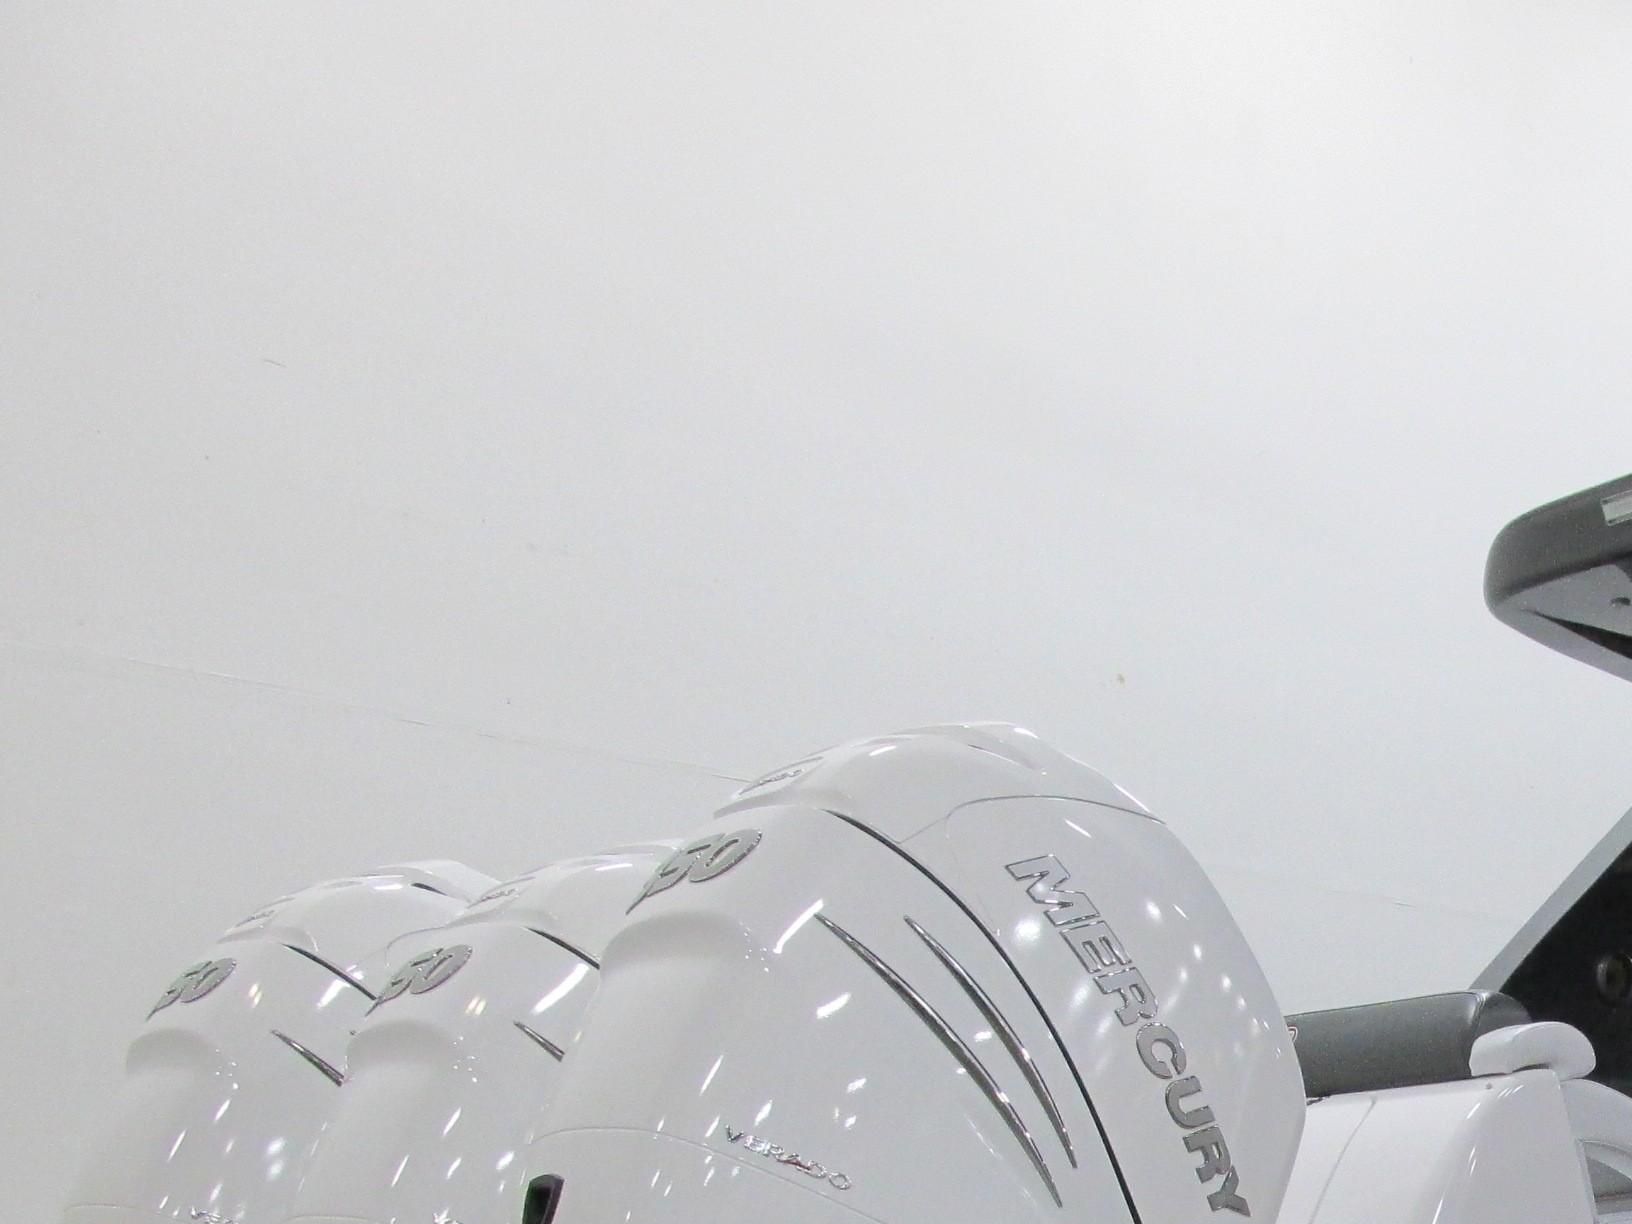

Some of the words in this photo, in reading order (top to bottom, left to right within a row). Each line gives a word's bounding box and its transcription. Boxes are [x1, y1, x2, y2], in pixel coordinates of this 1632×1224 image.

[626, 828, 762, 914] 50
[364, 944, 473, 1017] 50
[1004, 854, 1251, 1217] MERCURY
[724, 1124, 852, 1191] VERADO
